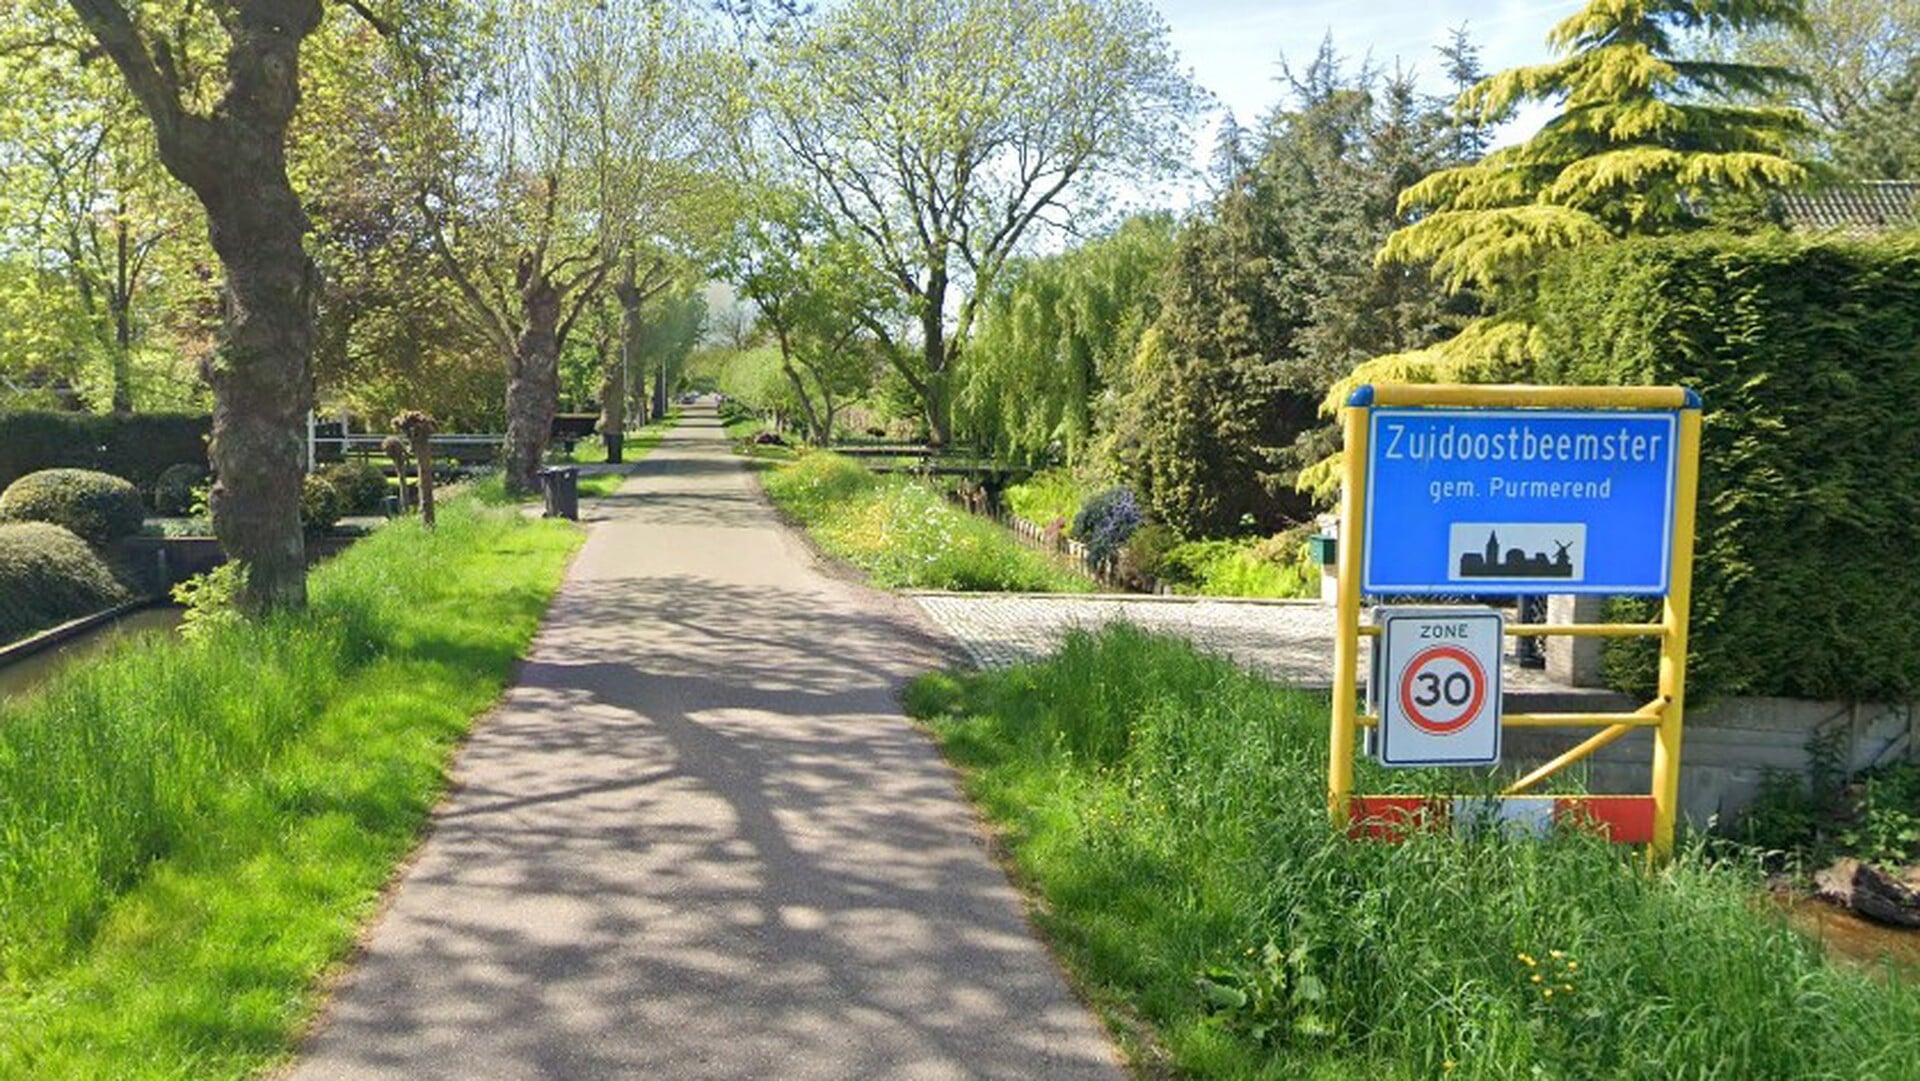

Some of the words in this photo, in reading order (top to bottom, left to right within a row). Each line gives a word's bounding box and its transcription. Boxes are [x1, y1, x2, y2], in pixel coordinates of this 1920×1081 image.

[1385, 424, 1662, 462] Zuidoostbeemster
[1429, 479, 1480, 503] gem.
[1491, 476, 1612, 499] Purmerend
[1420, 624, 1469, 638] ZONE
[1414, 671, 1471, 707] 30
